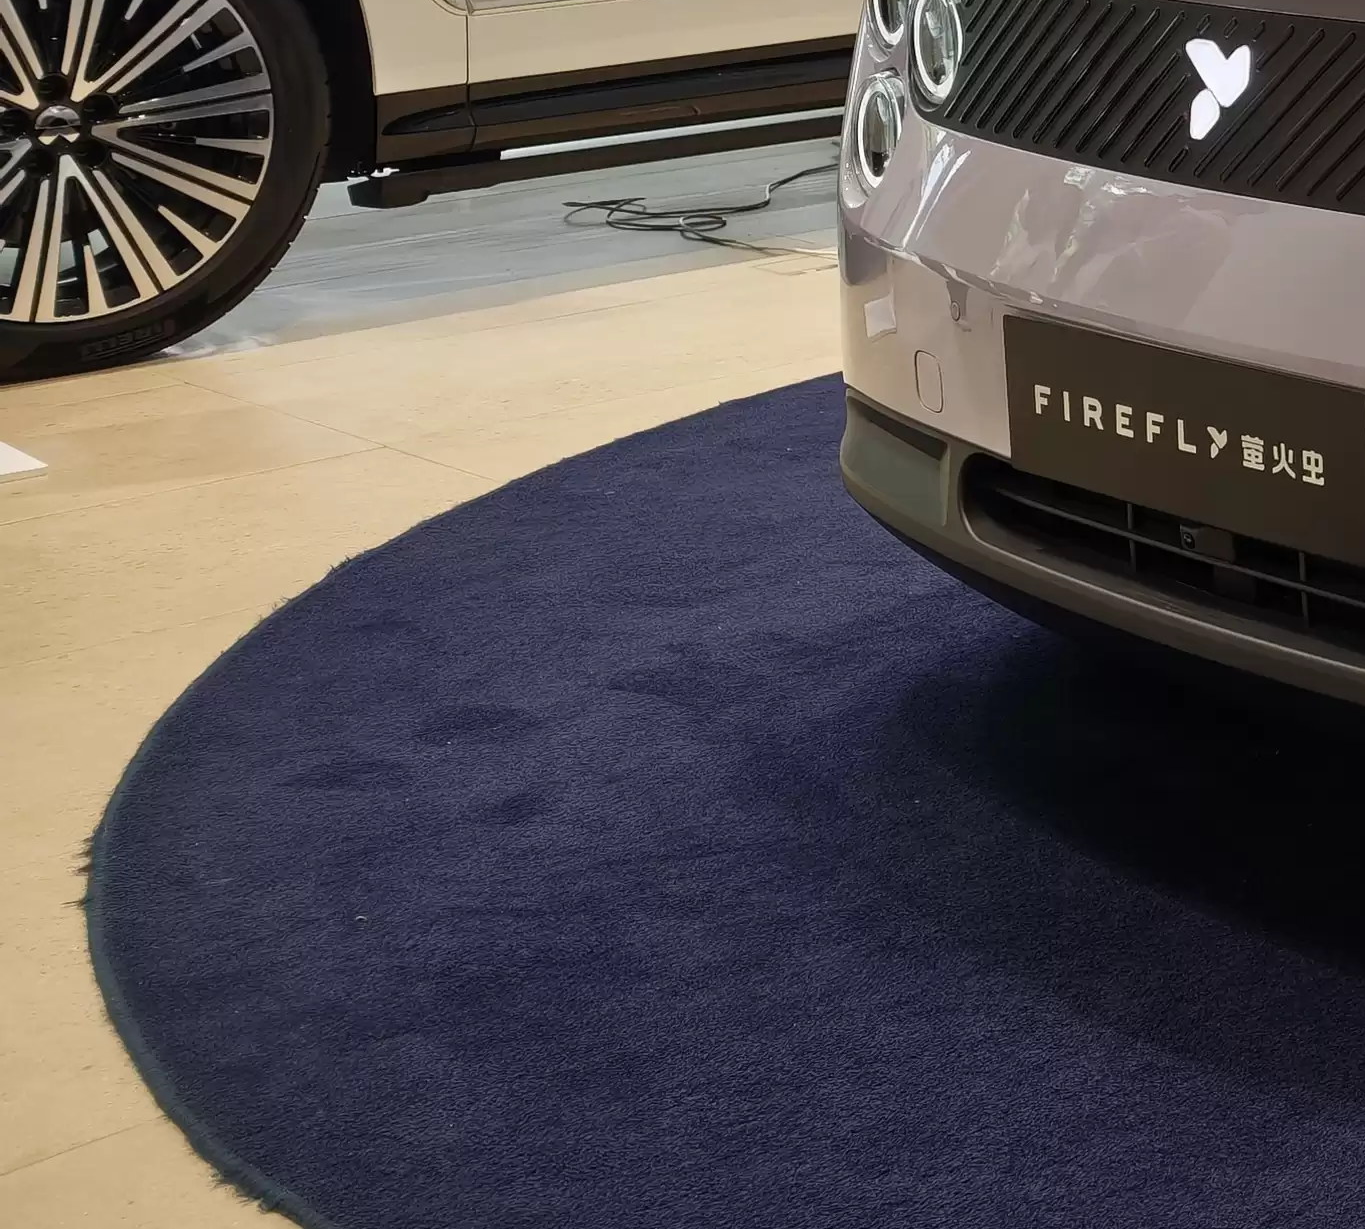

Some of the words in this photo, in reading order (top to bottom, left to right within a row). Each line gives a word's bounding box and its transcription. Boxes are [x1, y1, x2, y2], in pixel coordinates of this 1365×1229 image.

[1034, 384, 1228, 459] FIREFLY
[1240, 434, 1325, 486] 萤火虫
